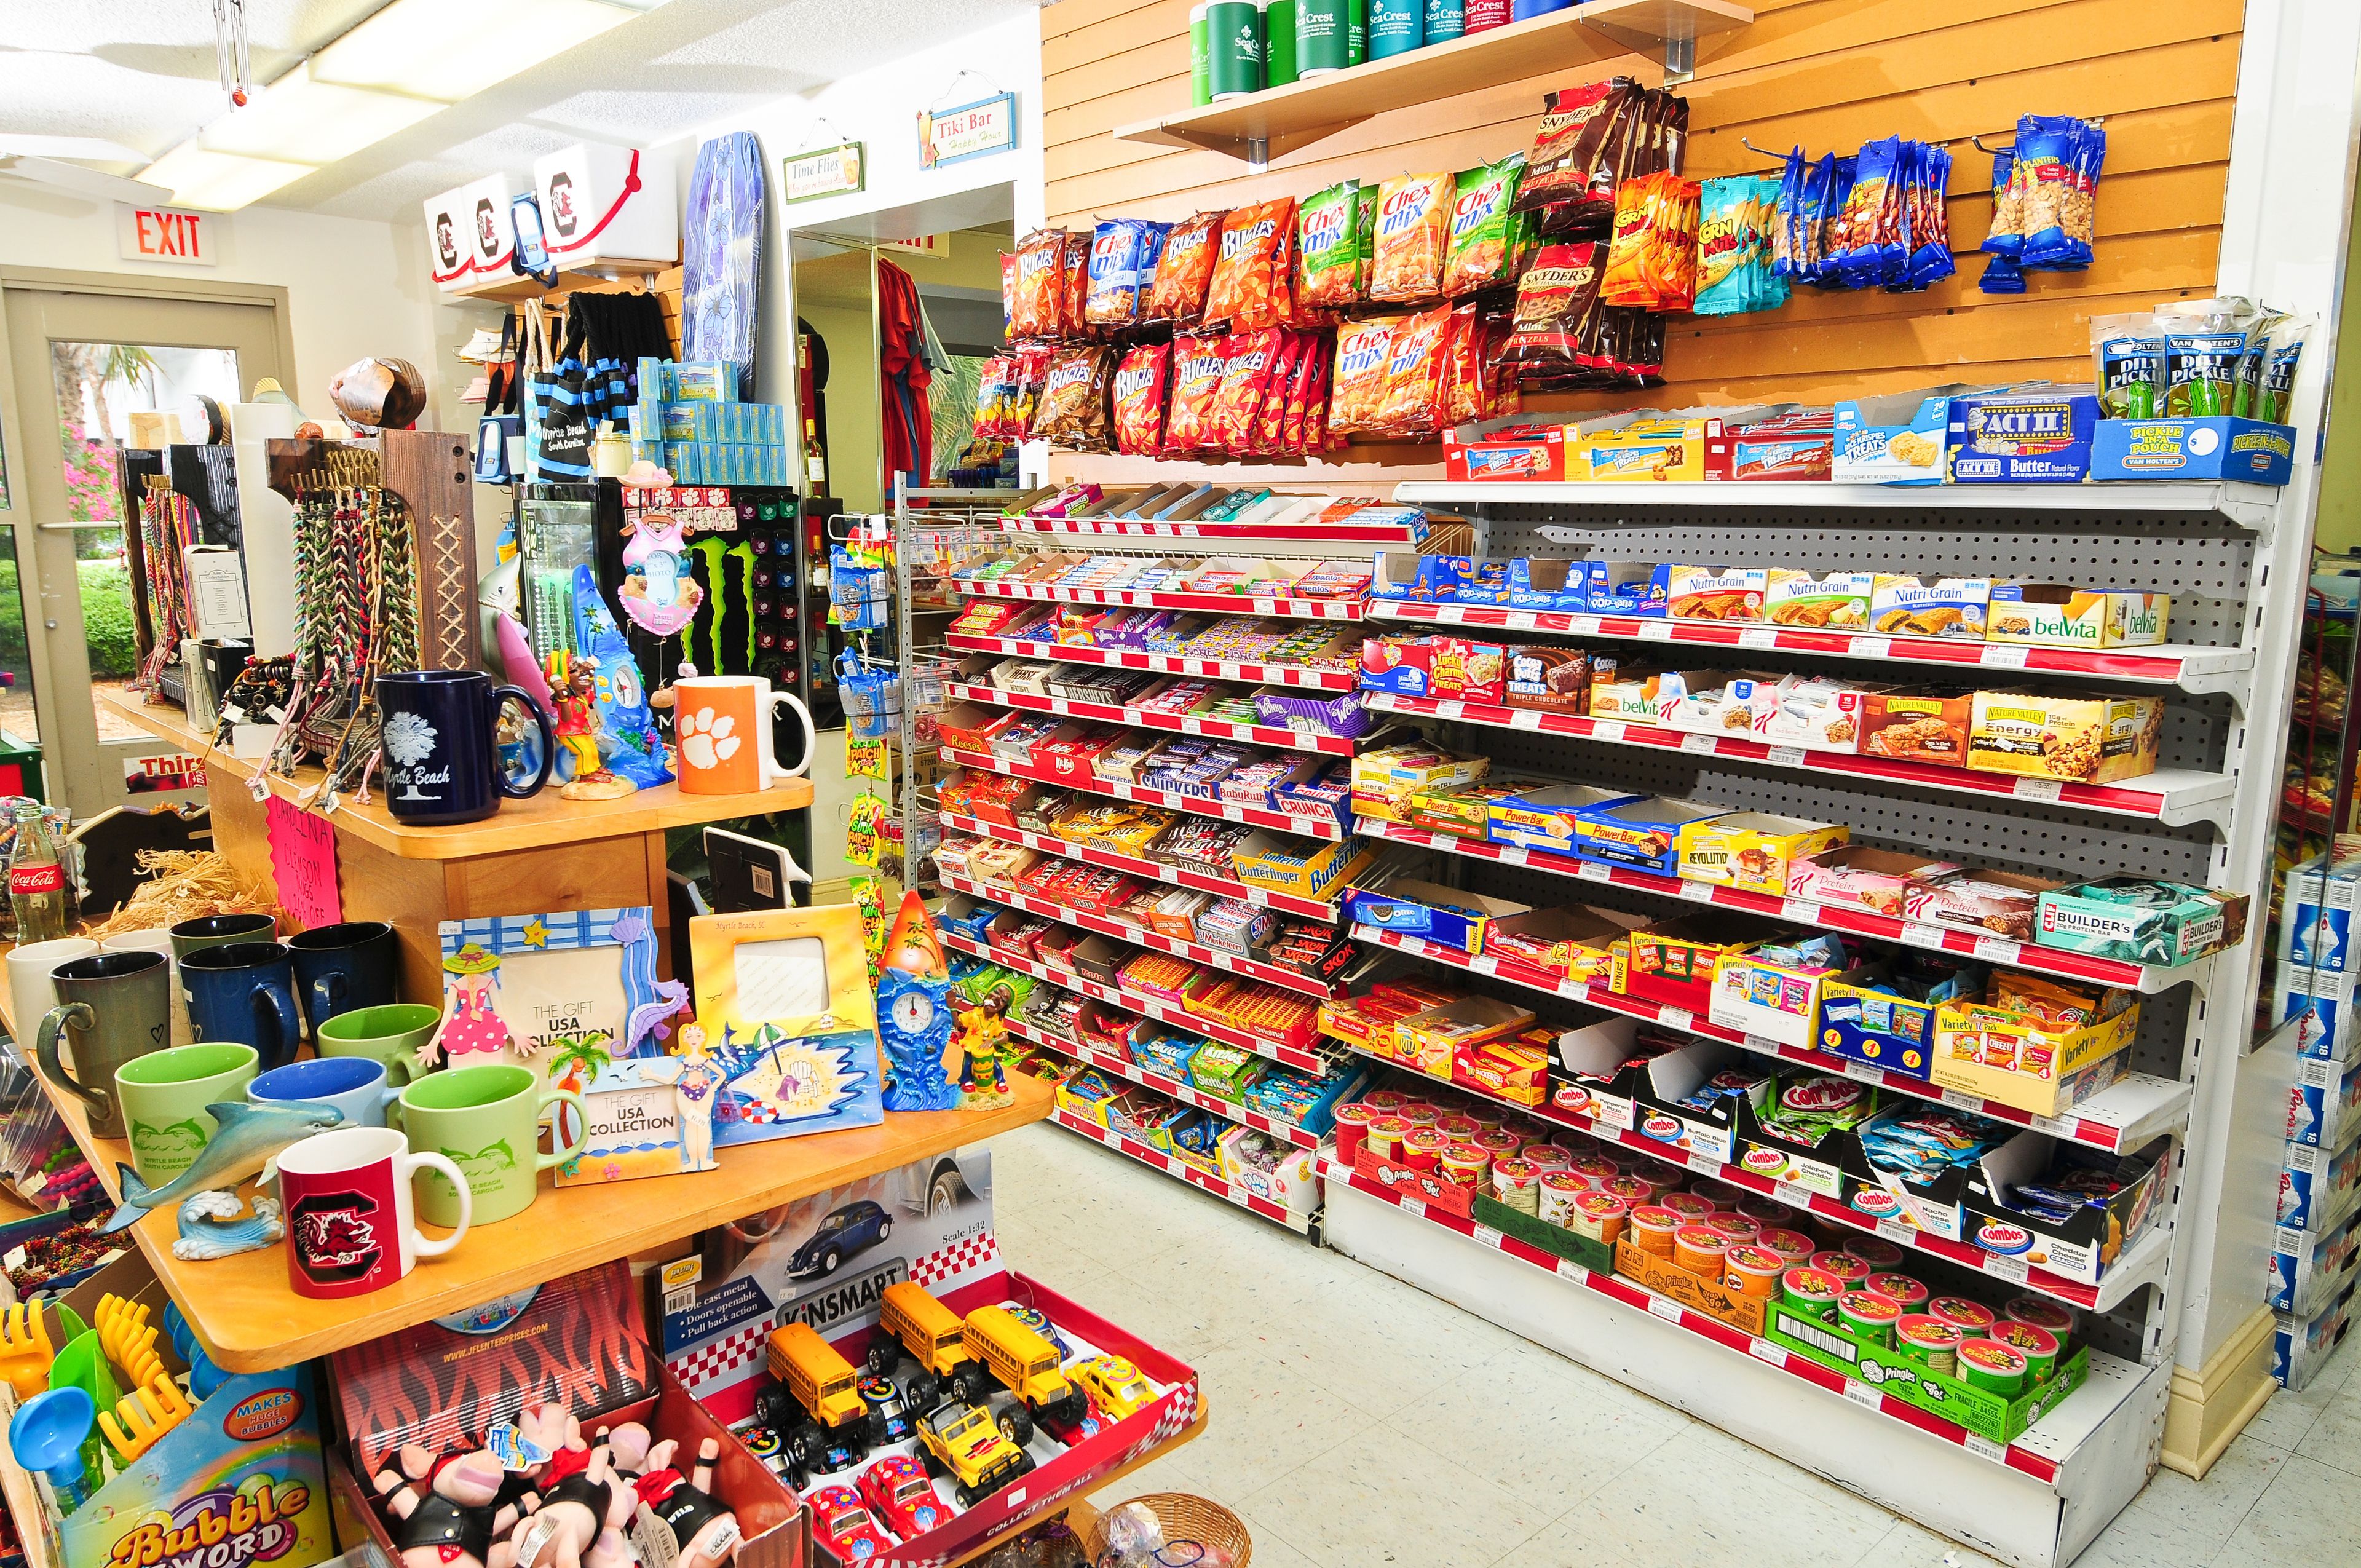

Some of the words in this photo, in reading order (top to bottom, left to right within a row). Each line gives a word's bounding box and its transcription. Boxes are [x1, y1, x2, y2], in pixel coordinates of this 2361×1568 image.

[1383, 12, 1411, 22] Crest
[938, 123, 963, 138] Tiki
[969, 113, 992, 129] Bar
[949, 140, 976, 151] Happy
[979, 130, 1001, 142] Hour
[792, 164, 814, 179] Time
[817, 159, 839, 174] Flies
[1531, 163, 1553, 176] Mini
[2022, 156, 2060, 171] PLANTERS
[1856, 176, 1886, 190] PLANTERS
[1383, 180, 1437, 216] Chex
[1383, 197, 1429, 235] mix
[1615, 204, 1649, 228] CORN
[136, 210, 200, 258] EXIT
[1698, 220, 1733, 244] CORN
[1222, 218, 1275, 263] BUGLES
[1524, 269, 1590, 287] SNYDER'S
[1517, 322, 1543, 331] Mini
[1342, 326, 1396, 355] Chex
[1342, 343, 1388, 373] mix
[2181, 355, 2223, 368] DILL
[1048, 366, 1090, 395] BUGLES
[1115, 367, 1154, 403] BUGLES
[1343, 373, 1375, 386] Cheddar
[1933, 402, 1944, 411] 20
[542, 426, 565, 441] Myrtle
[566, 423, 587, 437] Beach
[2132, 427, 2183, 438] PICKLE
[548, 440, 564, 451] South
[564, 438, 585, 449] Carolina
[1845, 439, 1887, 464] TREATS
[2131, 443, 2180, 454] POUCH
[1489, 457, 1511, 472] TREATS
[2009, 460, 2049, 474] Butter
[1300, 585, 1329, 594] mentos
[1690, 577, 1715, 592] Nutri
[1718, 577, 1744, 587] Grain
[1787, 582, 1814, 597] Nutri
[1817, 582, 1849, 593] Grain
[1894, 588, 1927, 604] Nutri
[1929, 587, 1963, 601] Grain
[2034, 616, 2097, 639] belVita
[1437, 654, 1462, 667] Lucky
[1513, 655, 1543, 670] Cocoa
[1433, 664, 1465, 678] Charms
[1434, 679, 1463, 691] TREATS
[1508, 681, 1547, 694] TREATS
[1066, 687, 1112, 704] HERSHEY'S
[1535, 695, 1568, 704] CHOCOLATE
[1889, 701, 1910, 713] NATURE
[1911, 701, 1941, 715] VALLEY
[1988, 708, 2014, 722] NATURE
[2014, 710, 2044, 724] VALLEY
[1985, 723, 2043, 738] Energy
[851, 747, 880, 761] PATCH
[415, 764, 450, 785] Beach
[1360, 782, 1387, 792] Energy
[1281, 800, 1334, 818] CRUNCH
[1425, 799, 1461, 814] PowerBar
[1505, 809, 1546, 825] PowerBar
[1592, 826, 1638, 844] PowerBar
[11, 870, 55, 887] Coca-Cola
[1239, 861, 1299, 883] Butterfinger
[1817, 876, 1856, 892] Protein
[1938, 897, 1981, 915] Protein
[2043, 903, 2056, 932] CLIF
[715, 921, 736, 930] Myrtle
[2068, 924, 2097, 934] PROTEIN
[1295, 939, 1328, 952] SKOR
[1550, 943, 1569, 957] 12
[1322, 943, 1356, 975] SKOR
[1546, 956, 1569, 965] Packs
[1667, 952, 1685, 962] CHEEZ-IT
[1695, 954, 1714, 967] CHEEZ-IT
[2331, 956, 2342, 970] 18
[1081, 968, 1105, 982] Rolo
[534, 1005, 560, 1020] THE
[563, 1001, 593, 1015] GIFT
[549, 1017, 580, 1032] USA
[1941, 1016, 1971, 1032] Variety
[1974, 1021, 1982, 1031] 12
[1254, 1025, 1285, 1039] Original
[1086, 1039, 1121, 1059] Skittles
[1988, 1037, 2014, 1051] CHEEZ-IT
[1145, 1061, 1184, 1082] Skittles
[1196, 1075, 1235, 1094] Skittles
[604, 1096, 627, 1109] THE
[630, 1092, 656, 1104] GIFT
[1558, 1090, 1584, 1102] Combos
[1066, 1099, 1097, 1118] Swedish
[1599, 1098, 1630, 1111] Pepperoni
[617, 1107, 644, 1120] USA
[590, 1116, 674, 1136] COLLECTION
[1647, 1119, 1676, 1131] Combos
[1687, 1127, 1711, 1141] Buffalo
[1712, 1135, 1727, 1144] Blue
[1694, 1134, 1719, 1147] Cheese
[1747, 1150, 1779, 1165] Combos
[1394, 1170, 1414, 1181] Pringles
[1801, 1163, 1833, 1176] Jalapeño
[1801, 1168, 1832, 1181] Cheddar
[1454, 1174, 1475, 1184] Pringles
[1858, 1192, 1893, 1206] Combos
[1921, 1206, 1948, 1217] Nacho
[942, 1229, 965, 1245] Scale
[967, 1220, 986, 1237] 1:32
[1982, 1227, 2023, 1241] Combos
[2051, 1242, 2088, 1258] Cheddar
[2052, 1249, 2085, 1264] Cheese
[2051, 1256, 2085, 1270] CRACKER
[1666, 1275, 1693, 1289] Pringles
[1702, 1289, 1718, 1301] grab
[686, 1310, 713, 1326] Doors
[716, 1291, 757, 1318] openable
[687, 1327, 705, 1338] Pull
[706, 1317, 727, 1333] back
[728, 1302, 757, 1324] action
[443, 1323, 548, 1363] WWW.JFLENTERPRISES.COM
[1885, 1367, 1916, 1382] Pringles
[1923, 1380, 1937, 1391] grab
[237, 1392, 292, 1419] MAKES
[1954, 1392, 1977, 1409] FRAGILE
[250, 1409, 280, 1423] HUGE
[242, 1416, 287, 1436] BUBBLES
[986, 1502, 1039, 1537] COLLECT
[1041, 1486, 1070, 1511] THEM
[1072, 1473, 1094, 1492] ALL
[112, 1485, 310, 1568] Bubble
[144, 1524, 285, 1568] WORD
